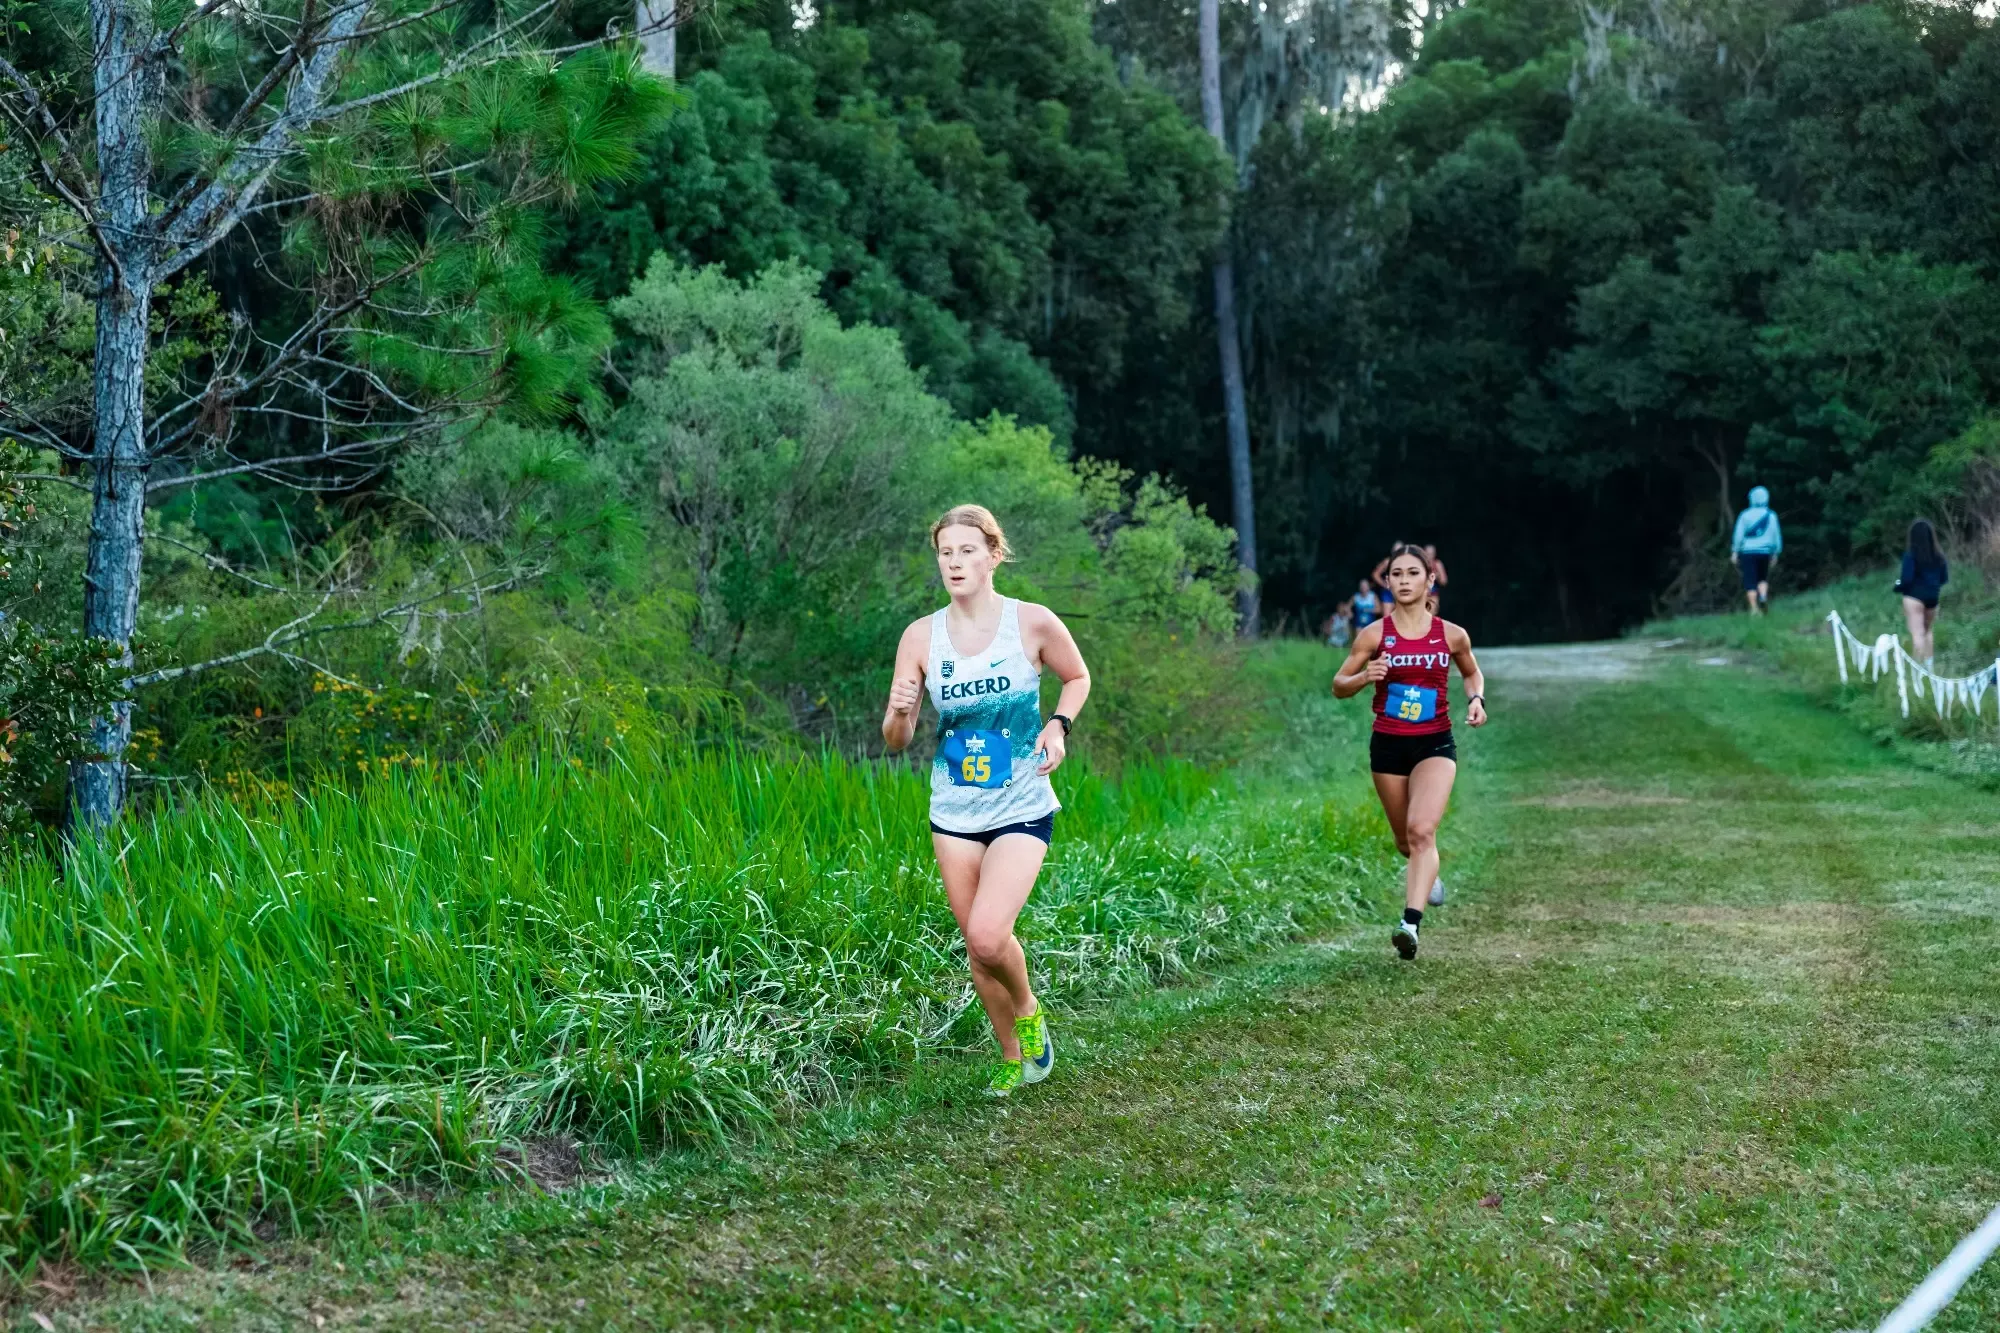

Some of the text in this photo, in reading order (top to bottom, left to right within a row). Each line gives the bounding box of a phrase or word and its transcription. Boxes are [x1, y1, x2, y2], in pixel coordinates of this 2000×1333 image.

[941, 676, 1011, 701] ECKERD
[1398, 700, 1423, 721] 59
[962, 755, 992, 783] 65
